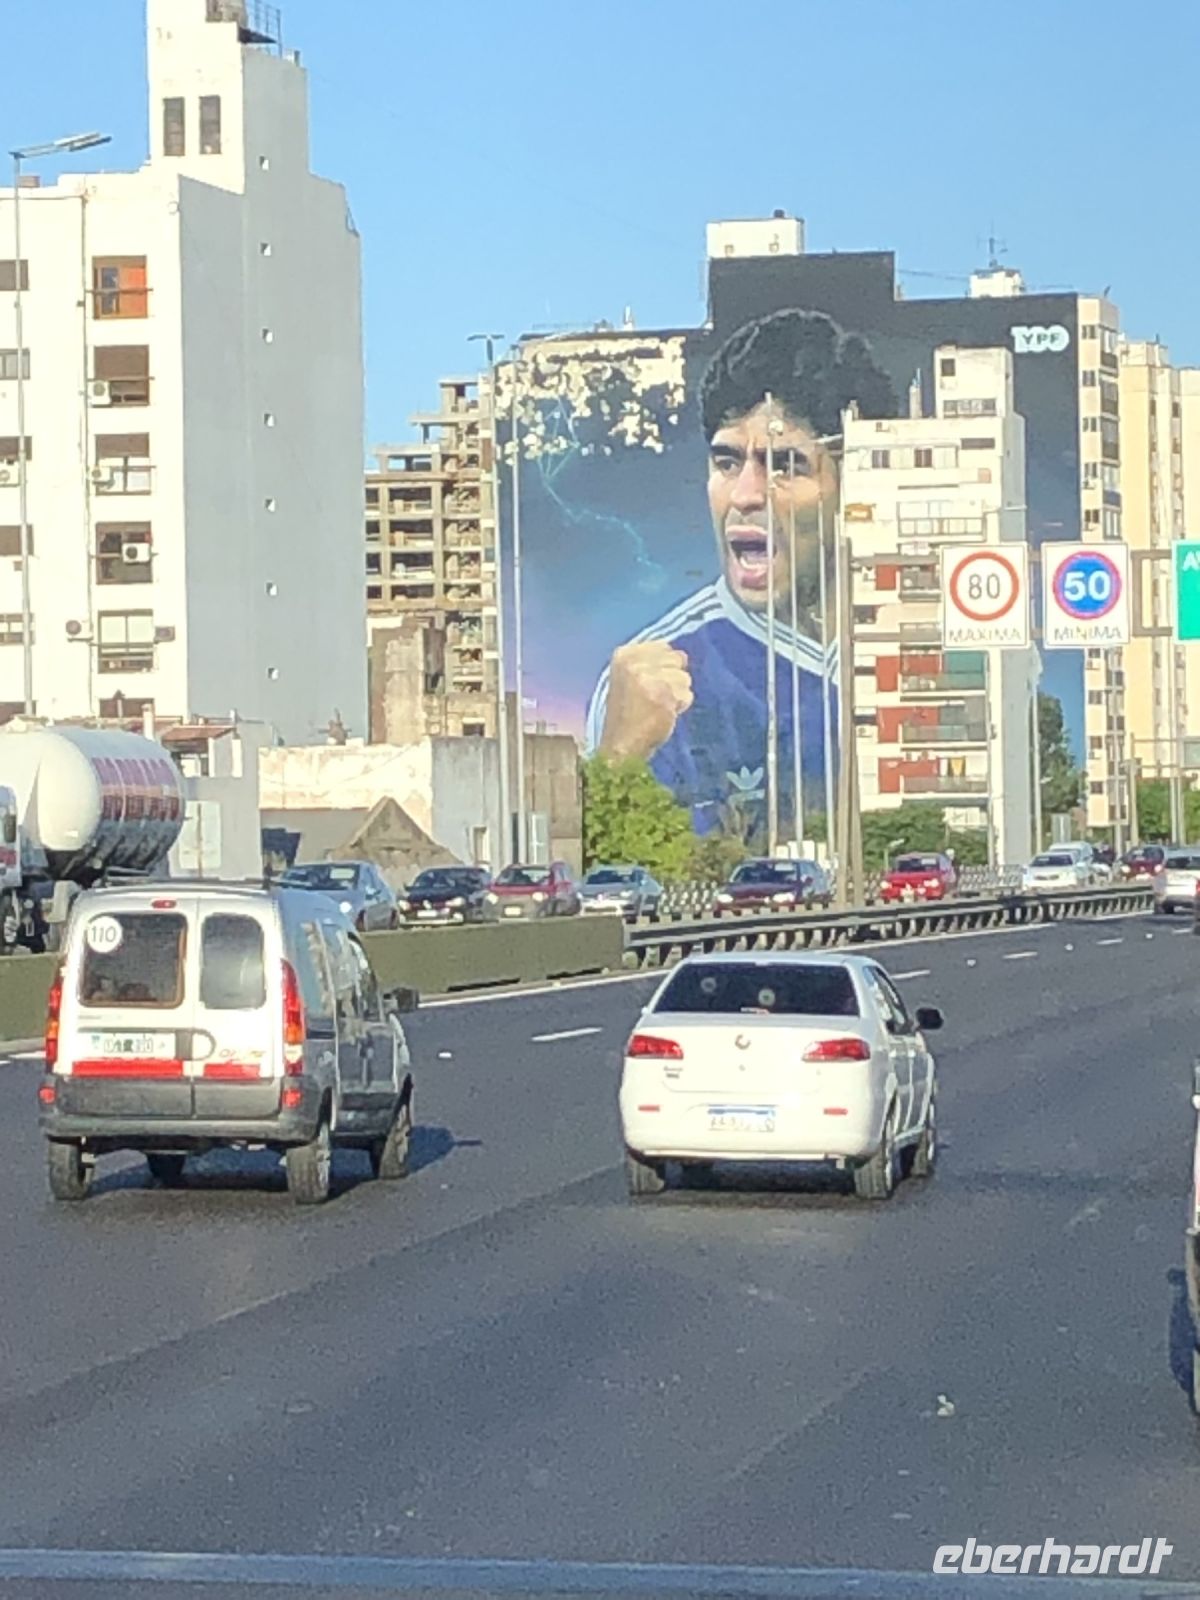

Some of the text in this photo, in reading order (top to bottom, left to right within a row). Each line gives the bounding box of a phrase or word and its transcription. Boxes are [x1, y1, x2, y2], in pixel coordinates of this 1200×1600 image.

[968, 572, 1001, 600] 80
[1062, 569, 1112, 602] 50
[91, 925, 117, 943] 110
